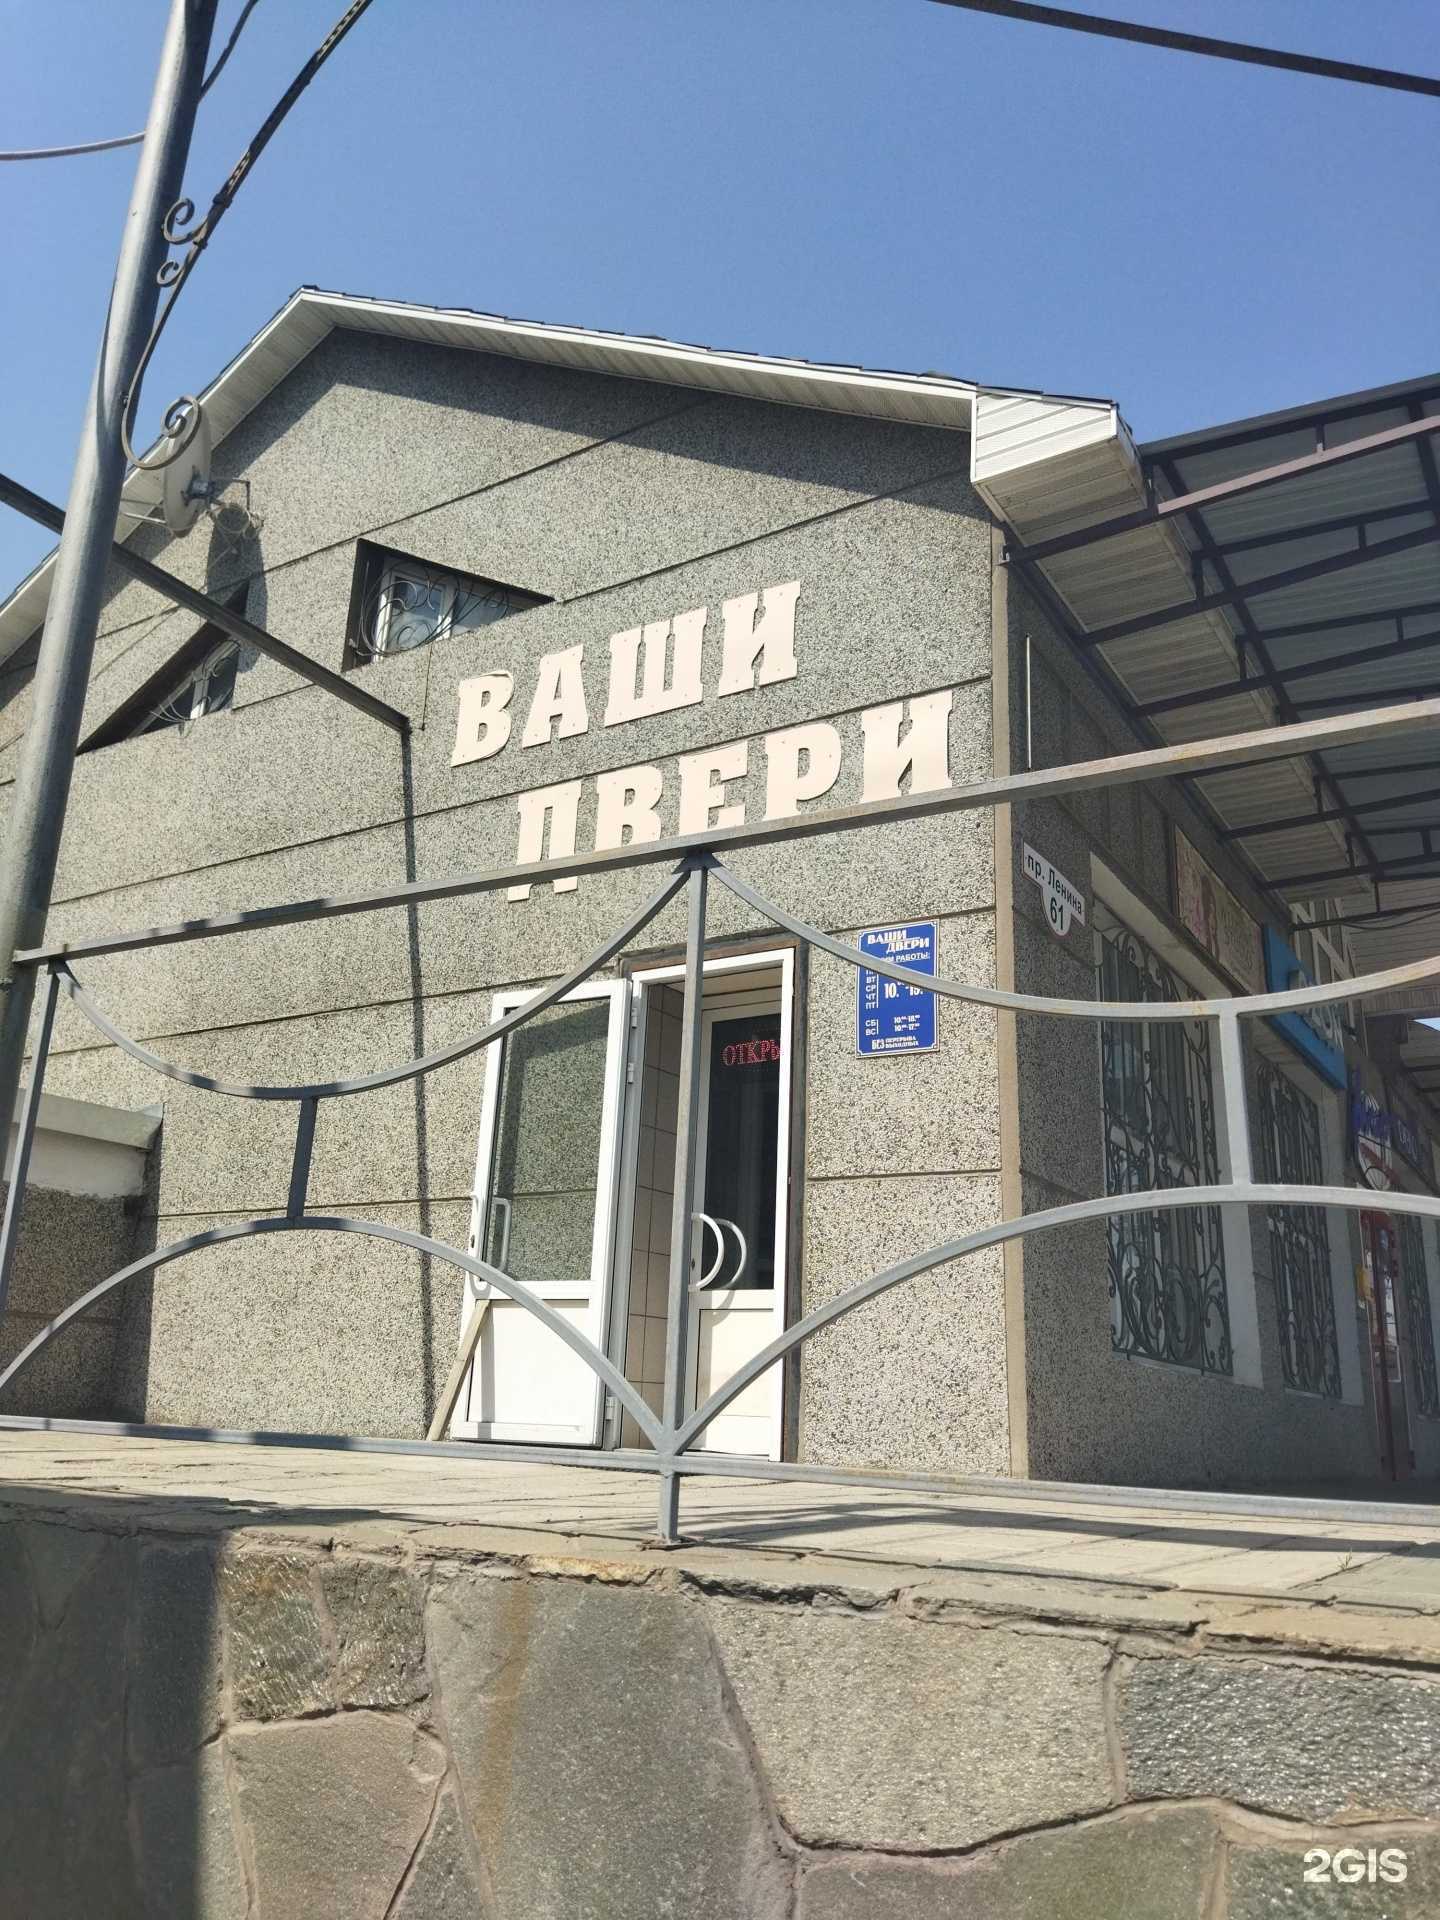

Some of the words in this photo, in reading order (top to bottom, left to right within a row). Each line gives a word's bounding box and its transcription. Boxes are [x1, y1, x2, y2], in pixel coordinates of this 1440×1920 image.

[451, 581, 801, 768] ВАШИ
[507, 690, 953, 902] ДВЕРИ
[1027, 855, 1045, 880] пр.
[1048, 868, 1082, 914] Ленина
[1050, 897, 1064, 930] 61
[867, 929, 907, 945] ВАШИ
[886, 937, 930, 954] ДВЕРИ
[865, 984, 877, 992] СР
[865, 993, 876, 1001] ЧТ
[865, 1019, 877, 1027] СБ
[865, 1028, 876, 1036] ВС
